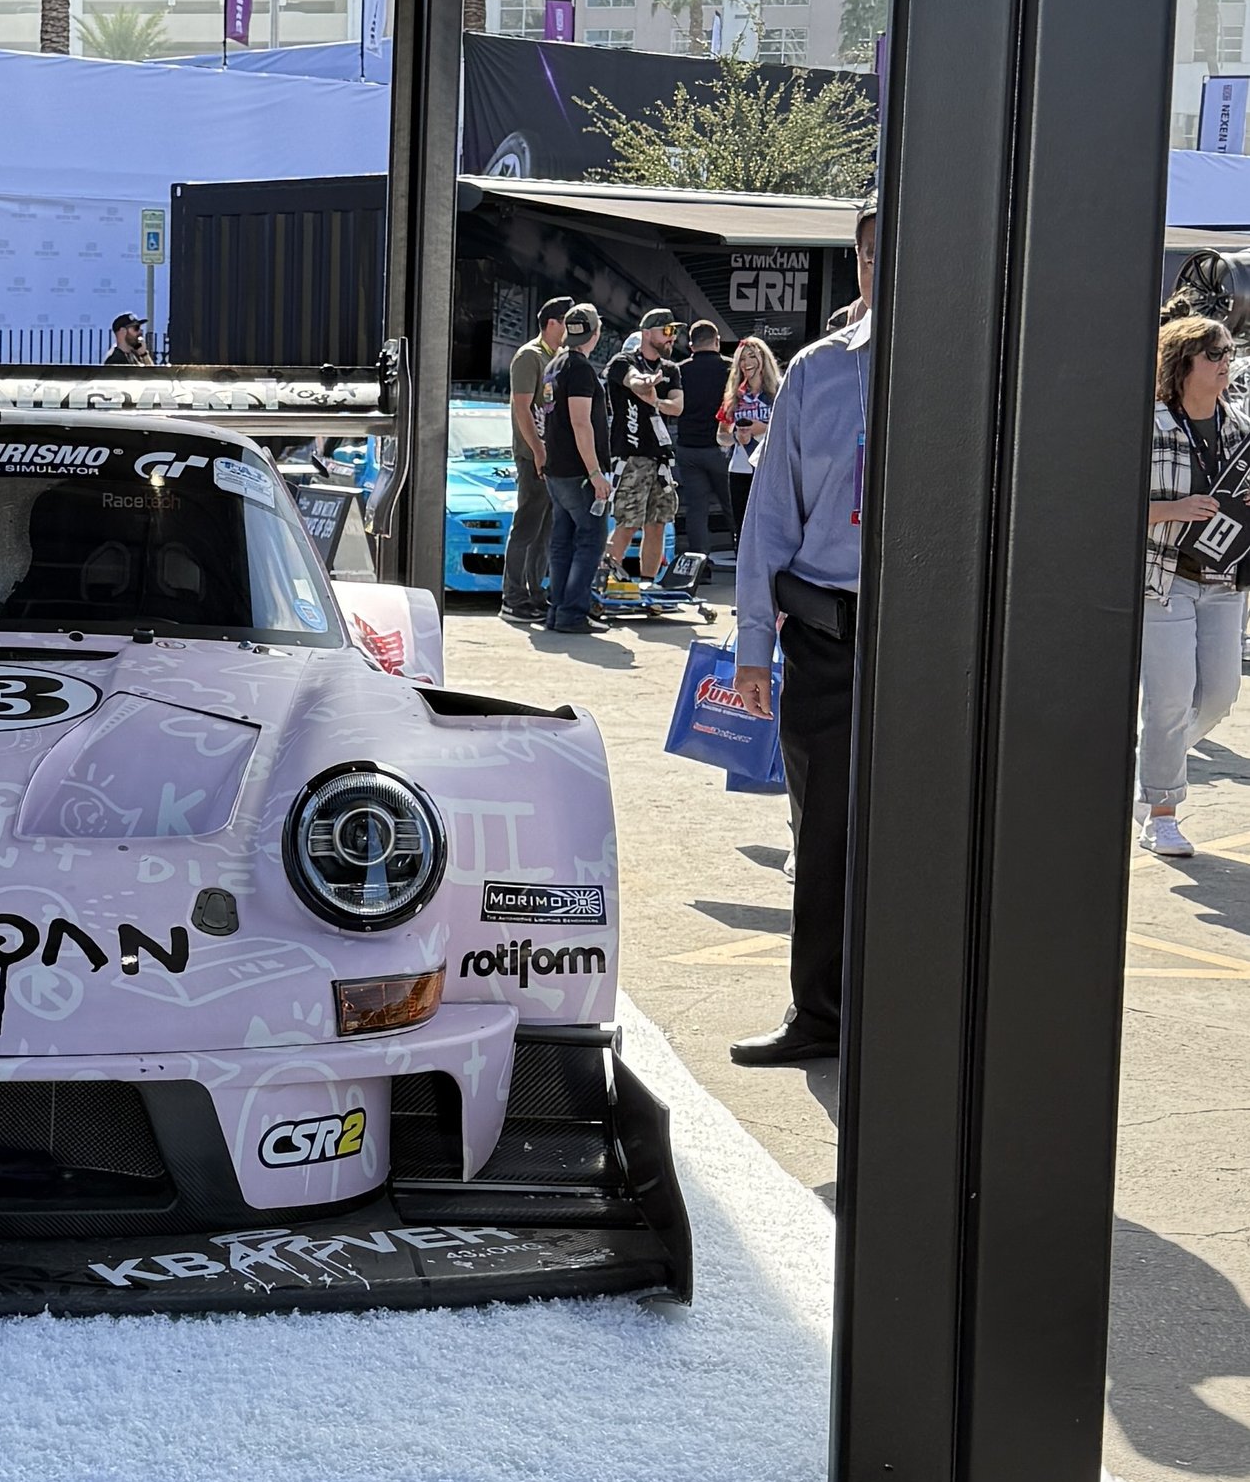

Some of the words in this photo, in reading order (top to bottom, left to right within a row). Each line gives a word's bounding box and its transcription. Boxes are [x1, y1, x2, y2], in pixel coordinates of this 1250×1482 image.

[1218, 104, 1231, 142] NEXEN
[5, 464, 99, 475] SIMULATOR
[102, 492, 181, 510] Racetech
[490, 892, 590, 907] MORIMOTO
[460, 939, 606, 988] rotiform
[261, 1111, 365, 1165] CSR2
